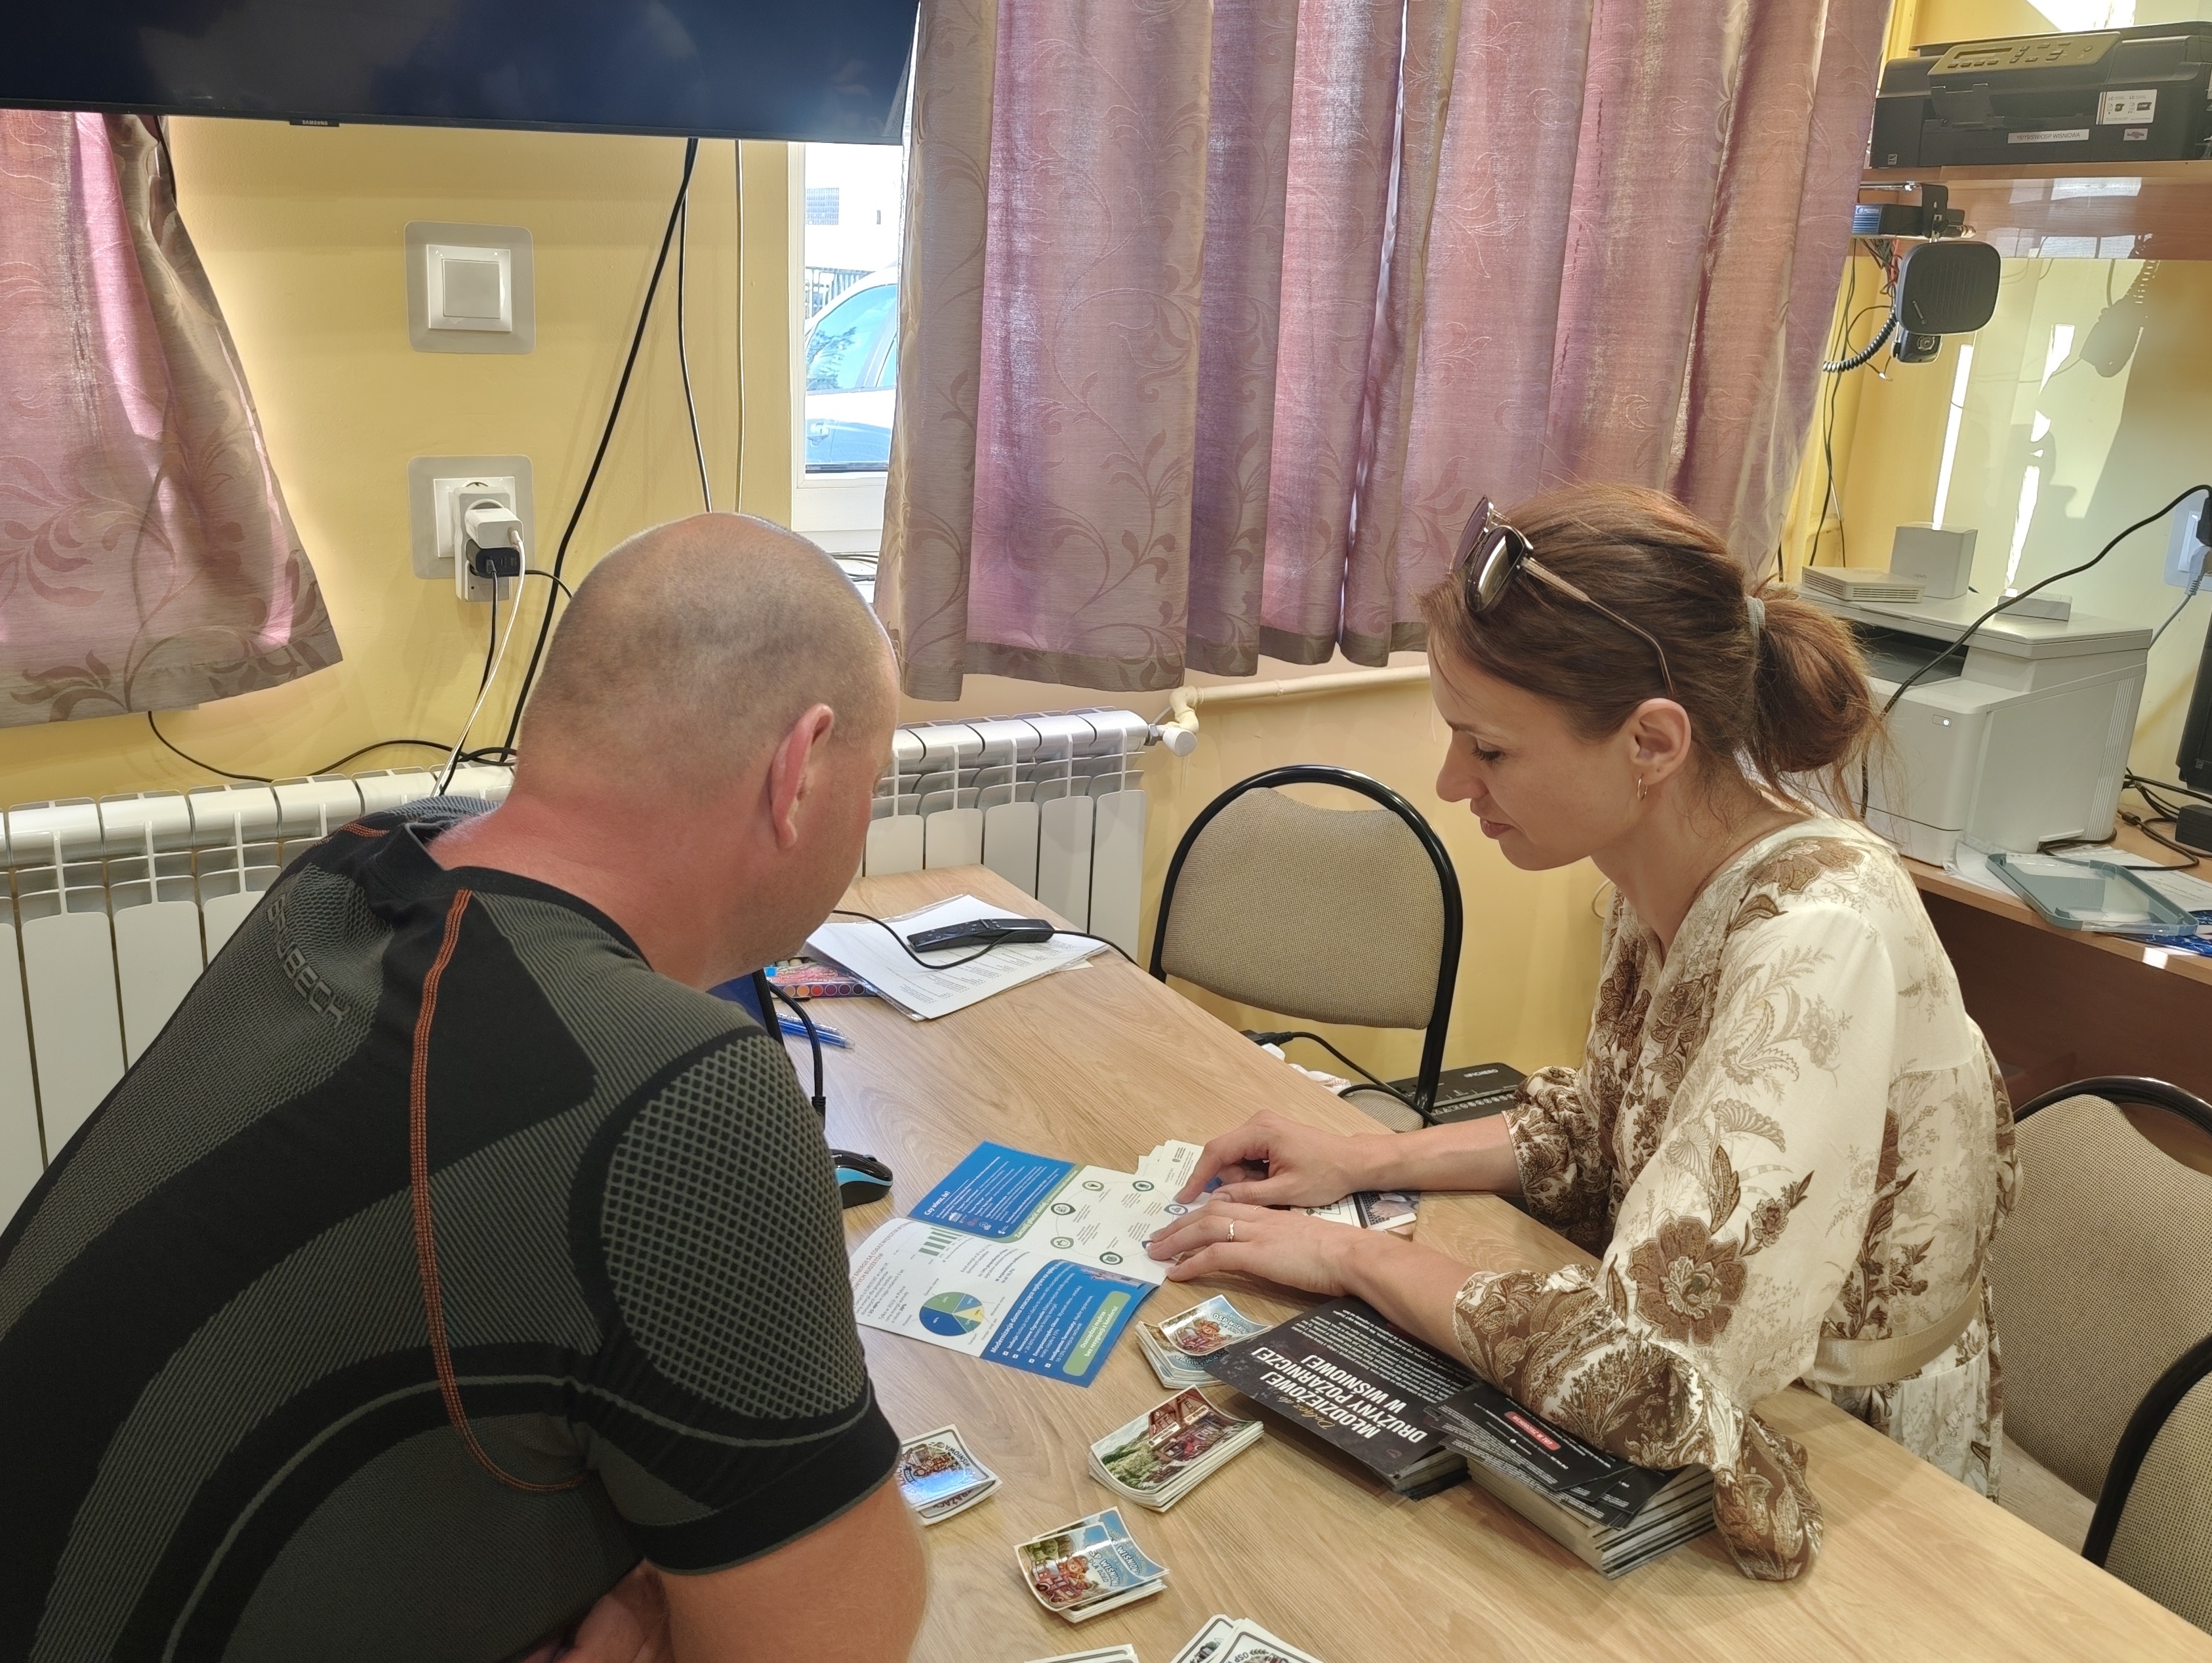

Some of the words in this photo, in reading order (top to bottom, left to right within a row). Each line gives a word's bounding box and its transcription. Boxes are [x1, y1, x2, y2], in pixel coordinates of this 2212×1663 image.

[990, 1323, 1013, 1353] Modernizacja
[1011, 1309, 1022, 1323] domu
[1080, 1325, 1098, 1347] Oszczędzaj
[1213, 1313, 1228, 1323] OSP
[1252, 1347, 1353, 1403] POŻARNICZEJ
[1301, 1355, 1387, 1403] WIŚNIOWEJ
[1261, 1372, 1379, 1437] MŁODZIEŻOWEJ
[1347, 1401, 1425, 1442] DRUŻYNY
[1383, 1399, 1406, 1413] W
[1235, 1651, 1250, 1662] OSP
